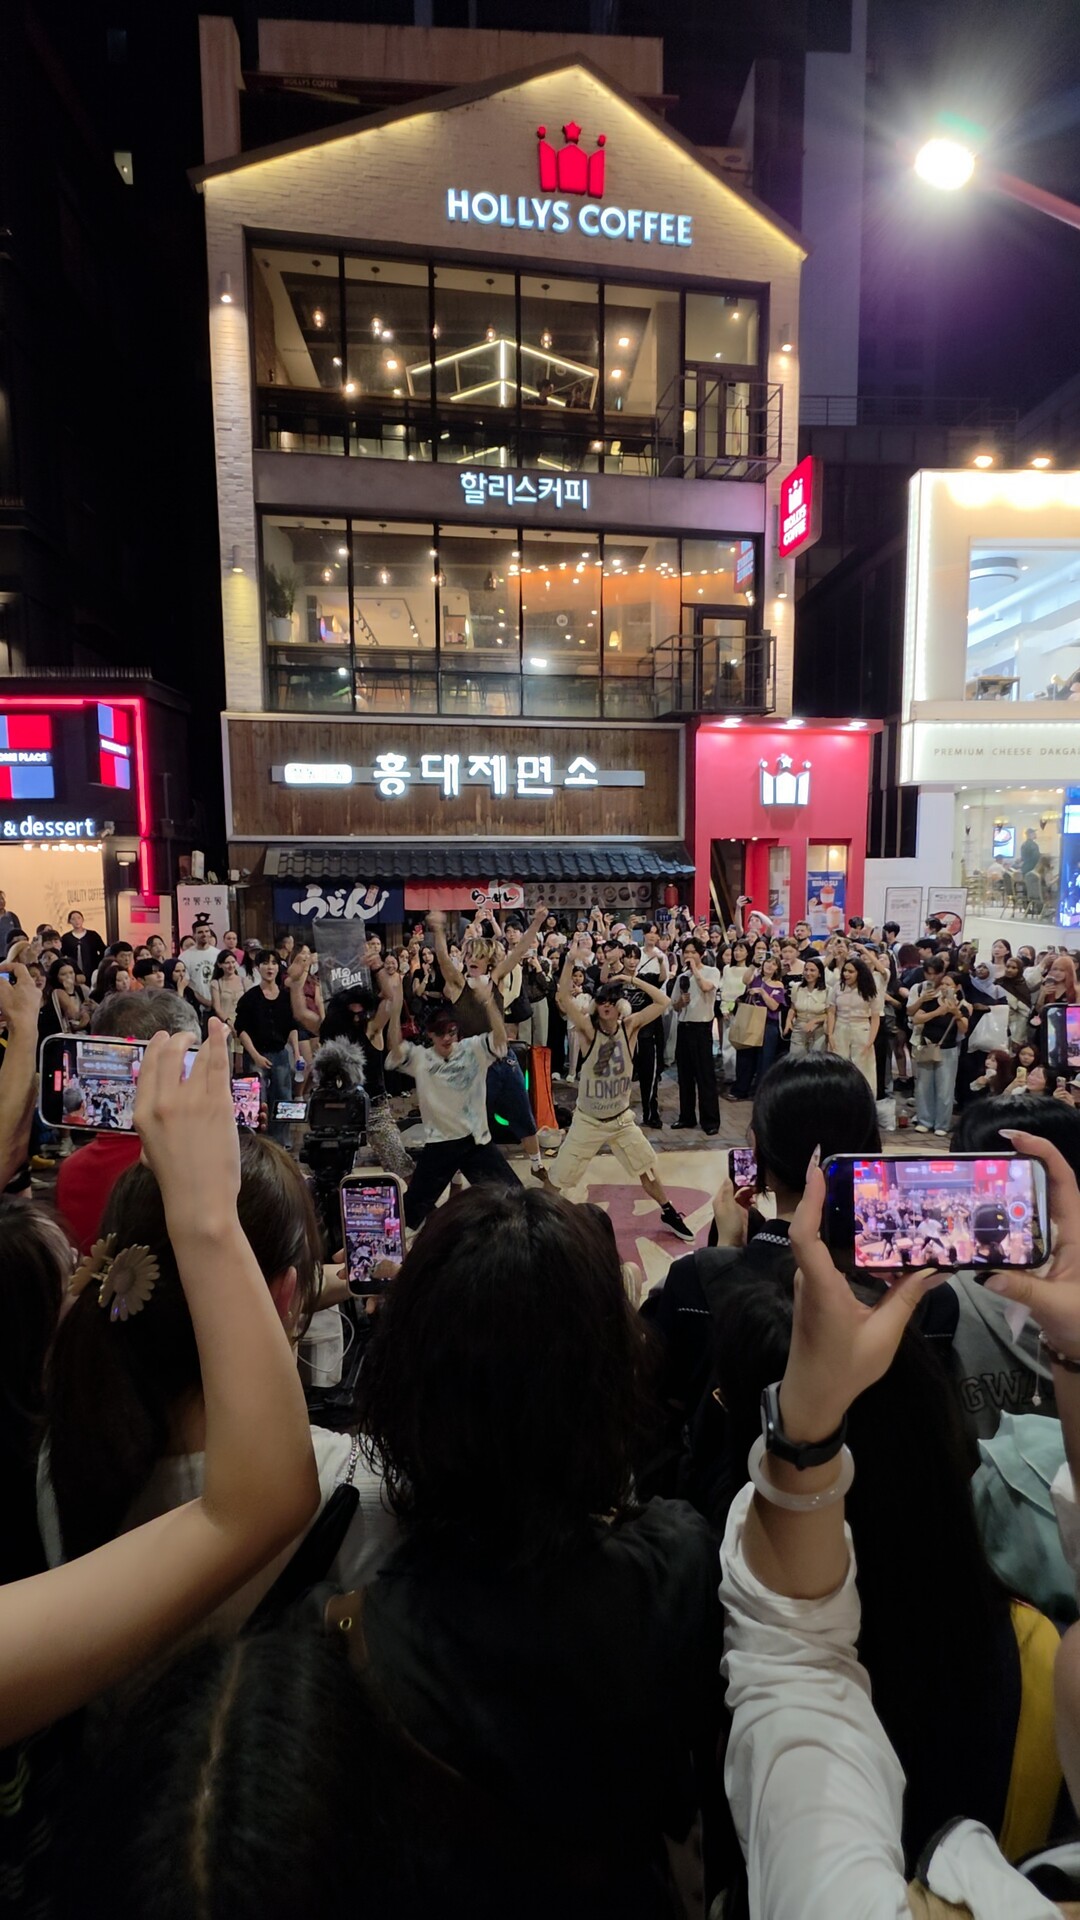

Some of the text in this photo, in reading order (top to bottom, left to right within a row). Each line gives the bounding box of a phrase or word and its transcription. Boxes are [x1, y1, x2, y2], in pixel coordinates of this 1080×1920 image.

[447, 188, 692, 247] HOLLYS COFFEE
[460, 471, 588, 509] 할리스커피
[18, 752, 48, 762] PLACE
[934, 748, 984, 756] PREMIUM
[992, 747, 1032, 756] CHEESE
[373, 752, 599, 796] 홍대제면소
[3, 815, 95, 836] & dessert
[292, 882, 390, 919] うどん
